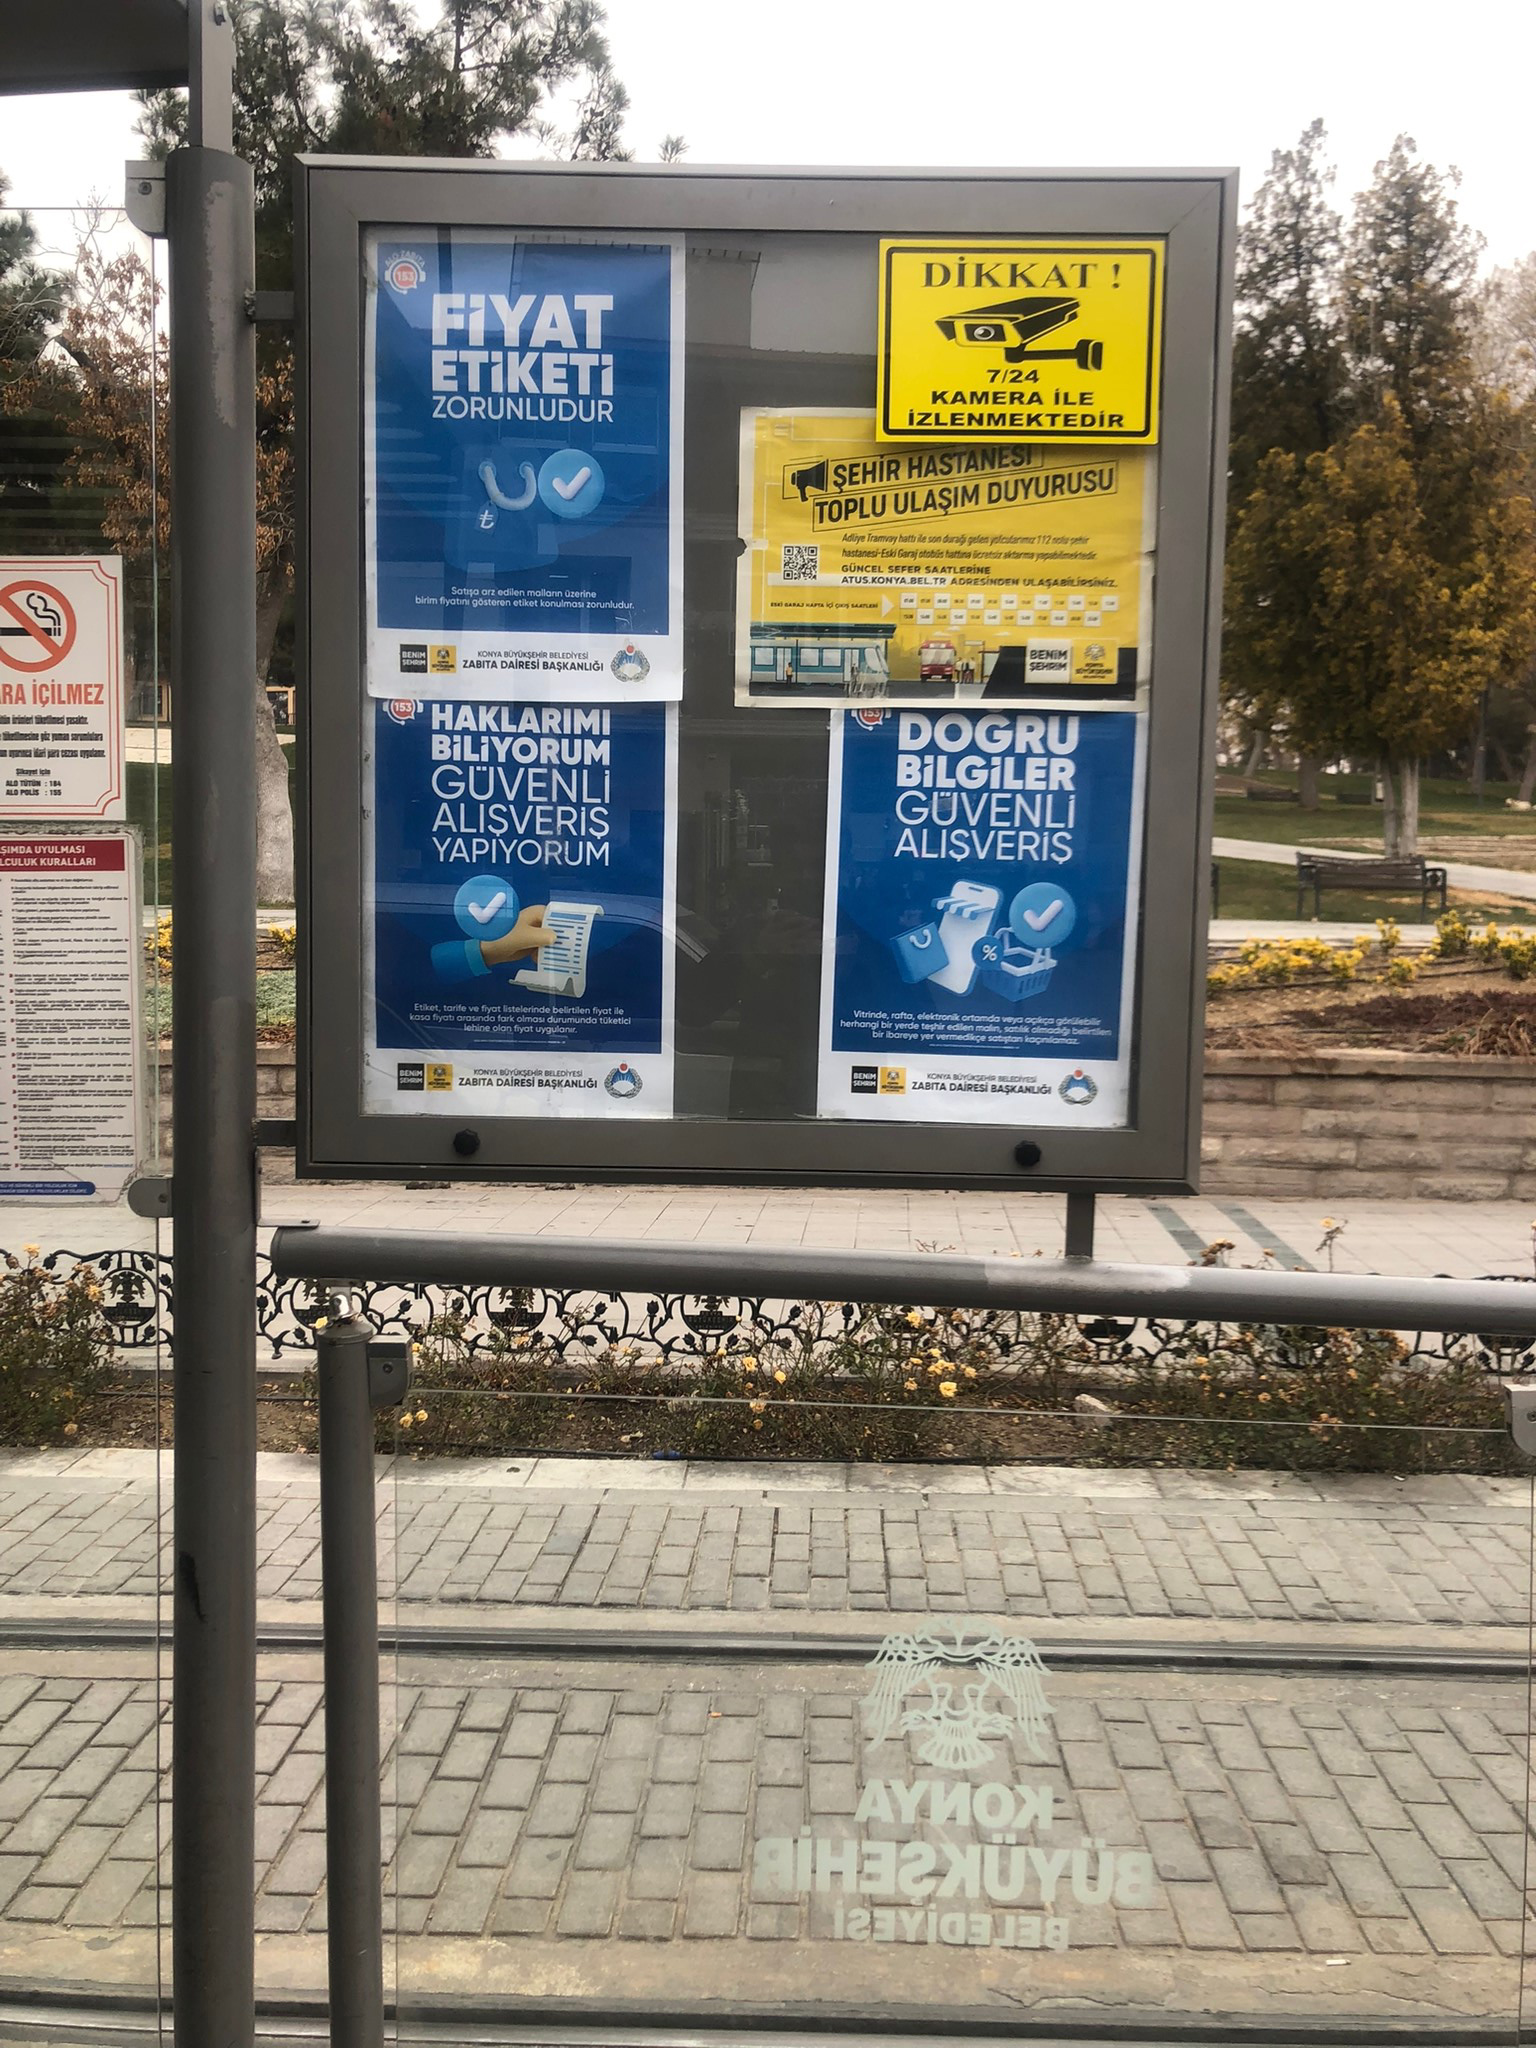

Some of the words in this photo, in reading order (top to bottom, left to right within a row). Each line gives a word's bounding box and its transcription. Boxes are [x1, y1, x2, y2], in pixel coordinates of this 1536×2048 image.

[398, 271, 414, 281] 153
[921, 256, 1098, 289] DİKKAT
[986, 369, 1040, 384] 7/24
[931, 390, 1044, 406] KAMERA
[1054, 389, 1094, 406] İLE
[432, 395, 614, 423] ZORUNLUDUR
[908, 409, 1124, 428] İZLENMEKTEDİR
[832, 456, 901, 494] ŞEHİR
[815, 494, 887, 524] TOPLU
[893, 483, 980, 516] ULAŞIM
[987, 467, 1115, 505] DUYURUSU
[842, 533, 866, 545] Adliye
[867, 533, 898, 545] Tramvay
[898, 534, 917, 544] hattı
[918, 534, 927, 544] ile
[927, 536, 941, 544] son
[1036, 535, 1052, 545] 112
[842, 548, 897, 558] hastanesi-Eski
[897, 548, 918, 560] Garaj
[841, 562, 884, 573] GÜNCEL
[887, 565, 921, 574] SEFER
[924, 564, 991, 575] SAATLERİNE
[841, 576, 947, 585] ATUS.KONYA.BEL.TR
[950, 576, 1019, 587] ADRESİNDEN
[1022, 576, 1118, 589] ULAŞABİLİRSİNİZ.
[451, 587, 479, 597] Satışa
[497, 588, 524, 596] edilen
[527, 588, 563, 597] malların
[564, 590, 597, 598] üzerine
[415, 595, 438, 604] birim
[440, 596, 470, 607] fiyatını
[472, 598, 511, 608] gösteren
[513, 599, 538, 607] etiket
[540, 599, 584, 608] konulması
[586, 600, 635, 609] zorunludur.
[477, 650, 502, 658] KONYA
[504, 650, 548, 659] BÜYÜKŞEHİR
[549, 651, 589, 660] BELEDİYESİ
[462, 660, 498, 669] ZABITA
[500, 658, 540, 670] DAİRESİ
[542, 660, 604, 672] BAŞKANLIĞI
[0, 684, 27, 705] RA
[32, 679, 104, 708] İÇİLMEZ
[395, 702, 412, 712] 153
[431, 704, 611, 735] HAKLARIMI
[5, 779, 19, 787] ALO
[19, 778, 42, 787] TÜTÜN
[20, 788, 40, 796] POLİS
[34, 845, 86, 854] UYULMASI
[432, 836, 610, 867] YAPIYORUM
[40, 857, 96, 866] KURALLARI
[414, 1003, 441, 1012] Etiket,
[443, 1004, 467, 1012] tarife
[481, 1004, 501, 1014] fiyat
[503, 1005, 551, 1014] listelerinde
[552, 1006, 591, 1014] belirtilen
[592, 1006, 612, 1016] fiyat
[613, 1007, 624, 1015] ile
[409, 1013, 431, 1021] kasa
[432, 1013, 455, 1023] fiyatı
[456, 1014, 496, 1022] arasında
[497, 1015, 515, 1023] fark
[517, 1015, 545, 1023] olması
[546, 1015, 597, 1024] durumunda
[599, 1017, 632, 1025] tüketici
[853, 1010, 890, 1020] Vitrinde,
[891, 1011, 916, 1021] rafta,
[917, 1012, 960, 1021] elektronik
[961, 1014, 1000, 1023] ortamda
[1002, 1016, 1024, 1025] veya
[1025, 1016, 1055, 1026] açıkça
[463, 1023, 491, 1032] lehine
[492, 1024, 512, 1032] olan
[513, 1025, 534, 1034] fiyat
[535, 1026, 578, 1034] uygulanır.
[840, 1019, 880, 1030] herhangi
[881, 1021, 893, 1029] bir
[894, 1022, 920, 1031] yerde
[921, 1023, 946, 1032] teşhir
[946, 1023, 974, 1032] edilen
[1031, 1026, 1071, 1036] olmadığı
[872, 1031, 884, 1039] bir
[886, 1031, 919, 1041] ibareye
[920, 1033, 935, 1041] yer
[935, 1034, 986, 1043] vermedikçe
[988, 1035, 1023, 1044] satıştan
[500, 1069, 544, 1077] BÜYÜKŞEHİR
[545, 1069, 583, 1077] BELEDİYESİ
[952, 1073, 997, 1082] BÜYÜKŞEHİR
[998, 1075, 1037, 1083] BELEDİYESİ
[458, 1078, 494, 1087] ZABITA
[496, 1077, 535, 1088] DAİRESİ
[537, 1078, 598, 1090] BAŞKANLIĞI
[912, 1082, 947, 1091] ZABITA
[949, 1082, 989, 1093] DAİRESİ
[990, 1084, 1051, 1095] BAŞKANLIĞI
